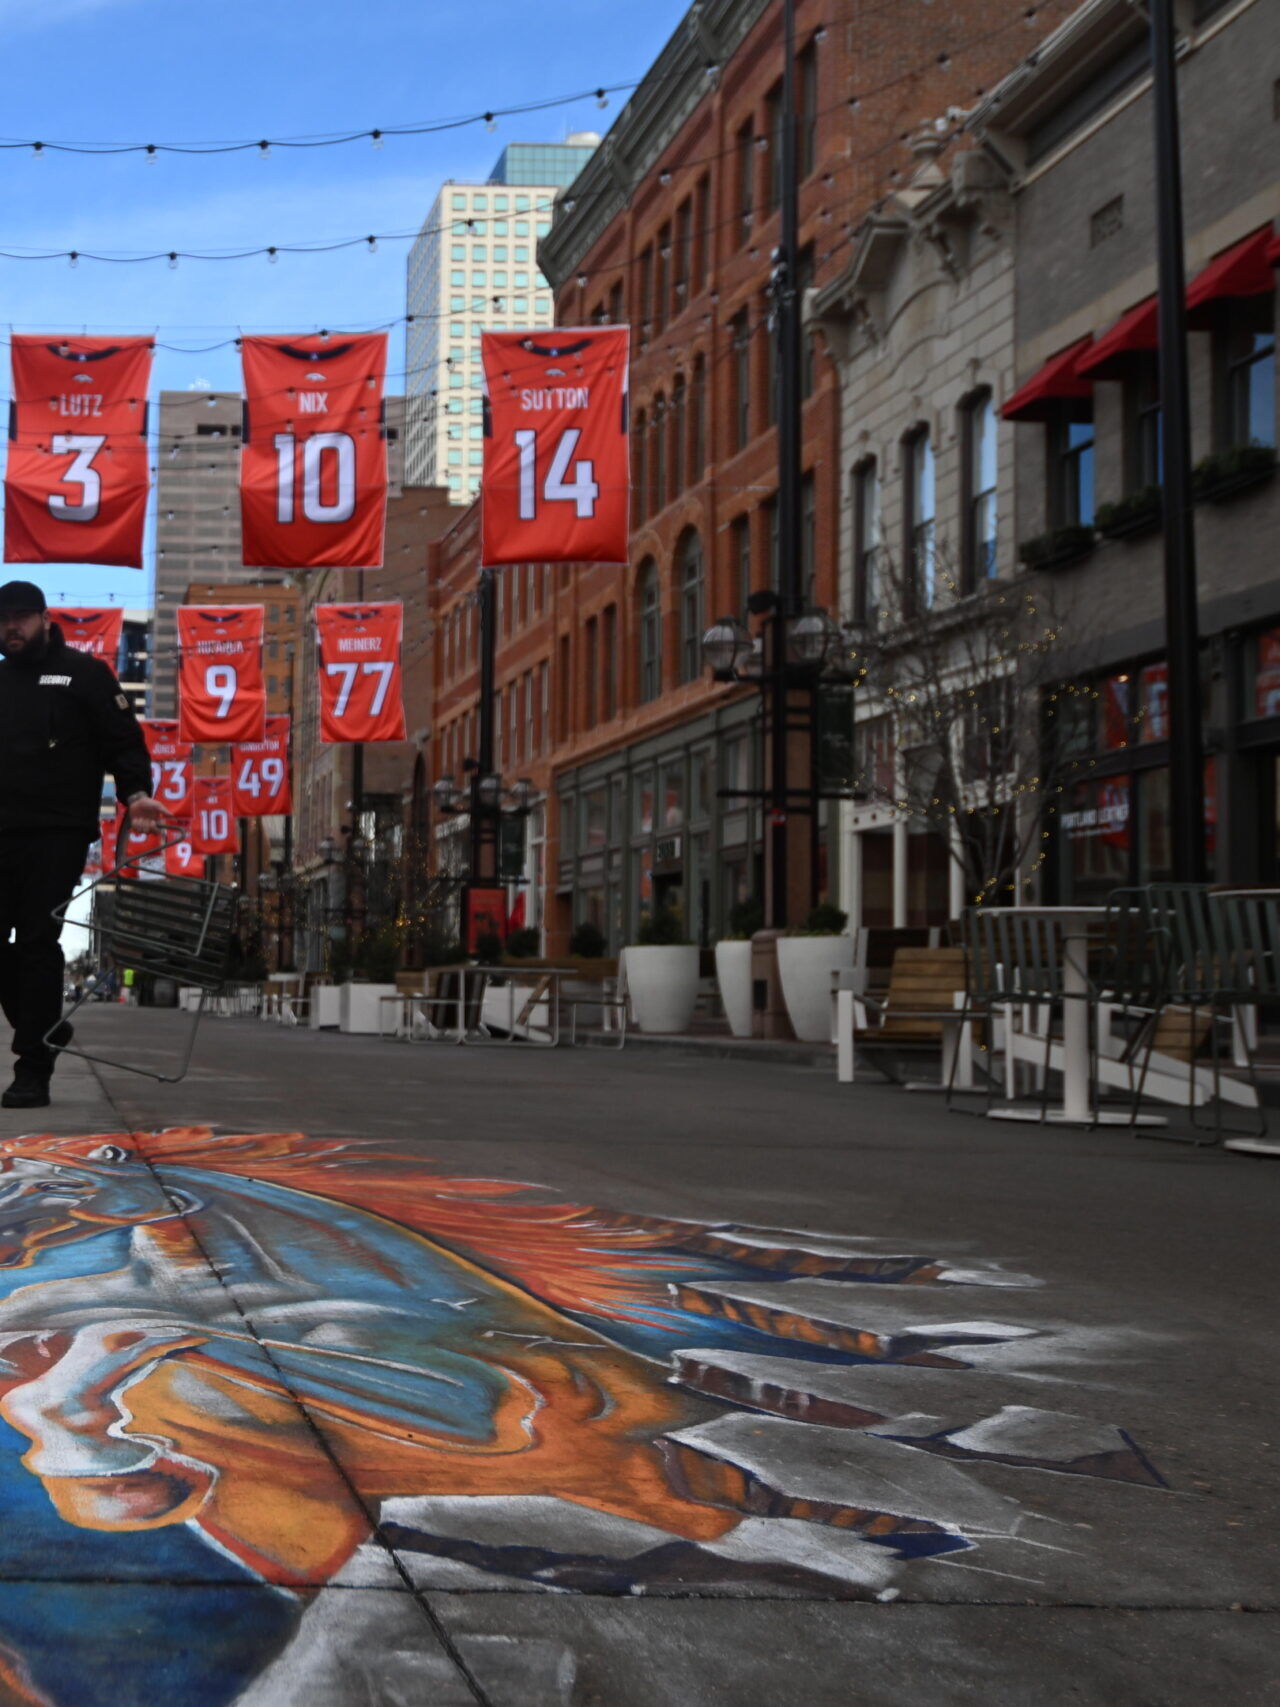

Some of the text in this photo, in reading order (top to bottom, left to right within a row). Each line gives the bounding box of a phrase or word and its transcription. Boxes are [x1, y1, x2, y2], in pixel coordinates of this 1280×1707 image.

[59, 393, 103, 416] LUTZ
[299, 392, 328, 413] NIX
[520, 387, 589, 411] SUTTON
[48, 434, 107, 522] 3
[274, 432, 356, 523] 10
[515, 428, 599, 520] 14
[338, 637, 382, 652] MEINERZ
[39, 674, 73, 687] SECURITY
[206, 664, 237, 717] 9
[327, 661, 395, 717] 77
[238, 758, 284, 798] 49
[200, 810, 228, 841] 10
[177, 841, 192, 868] 9
